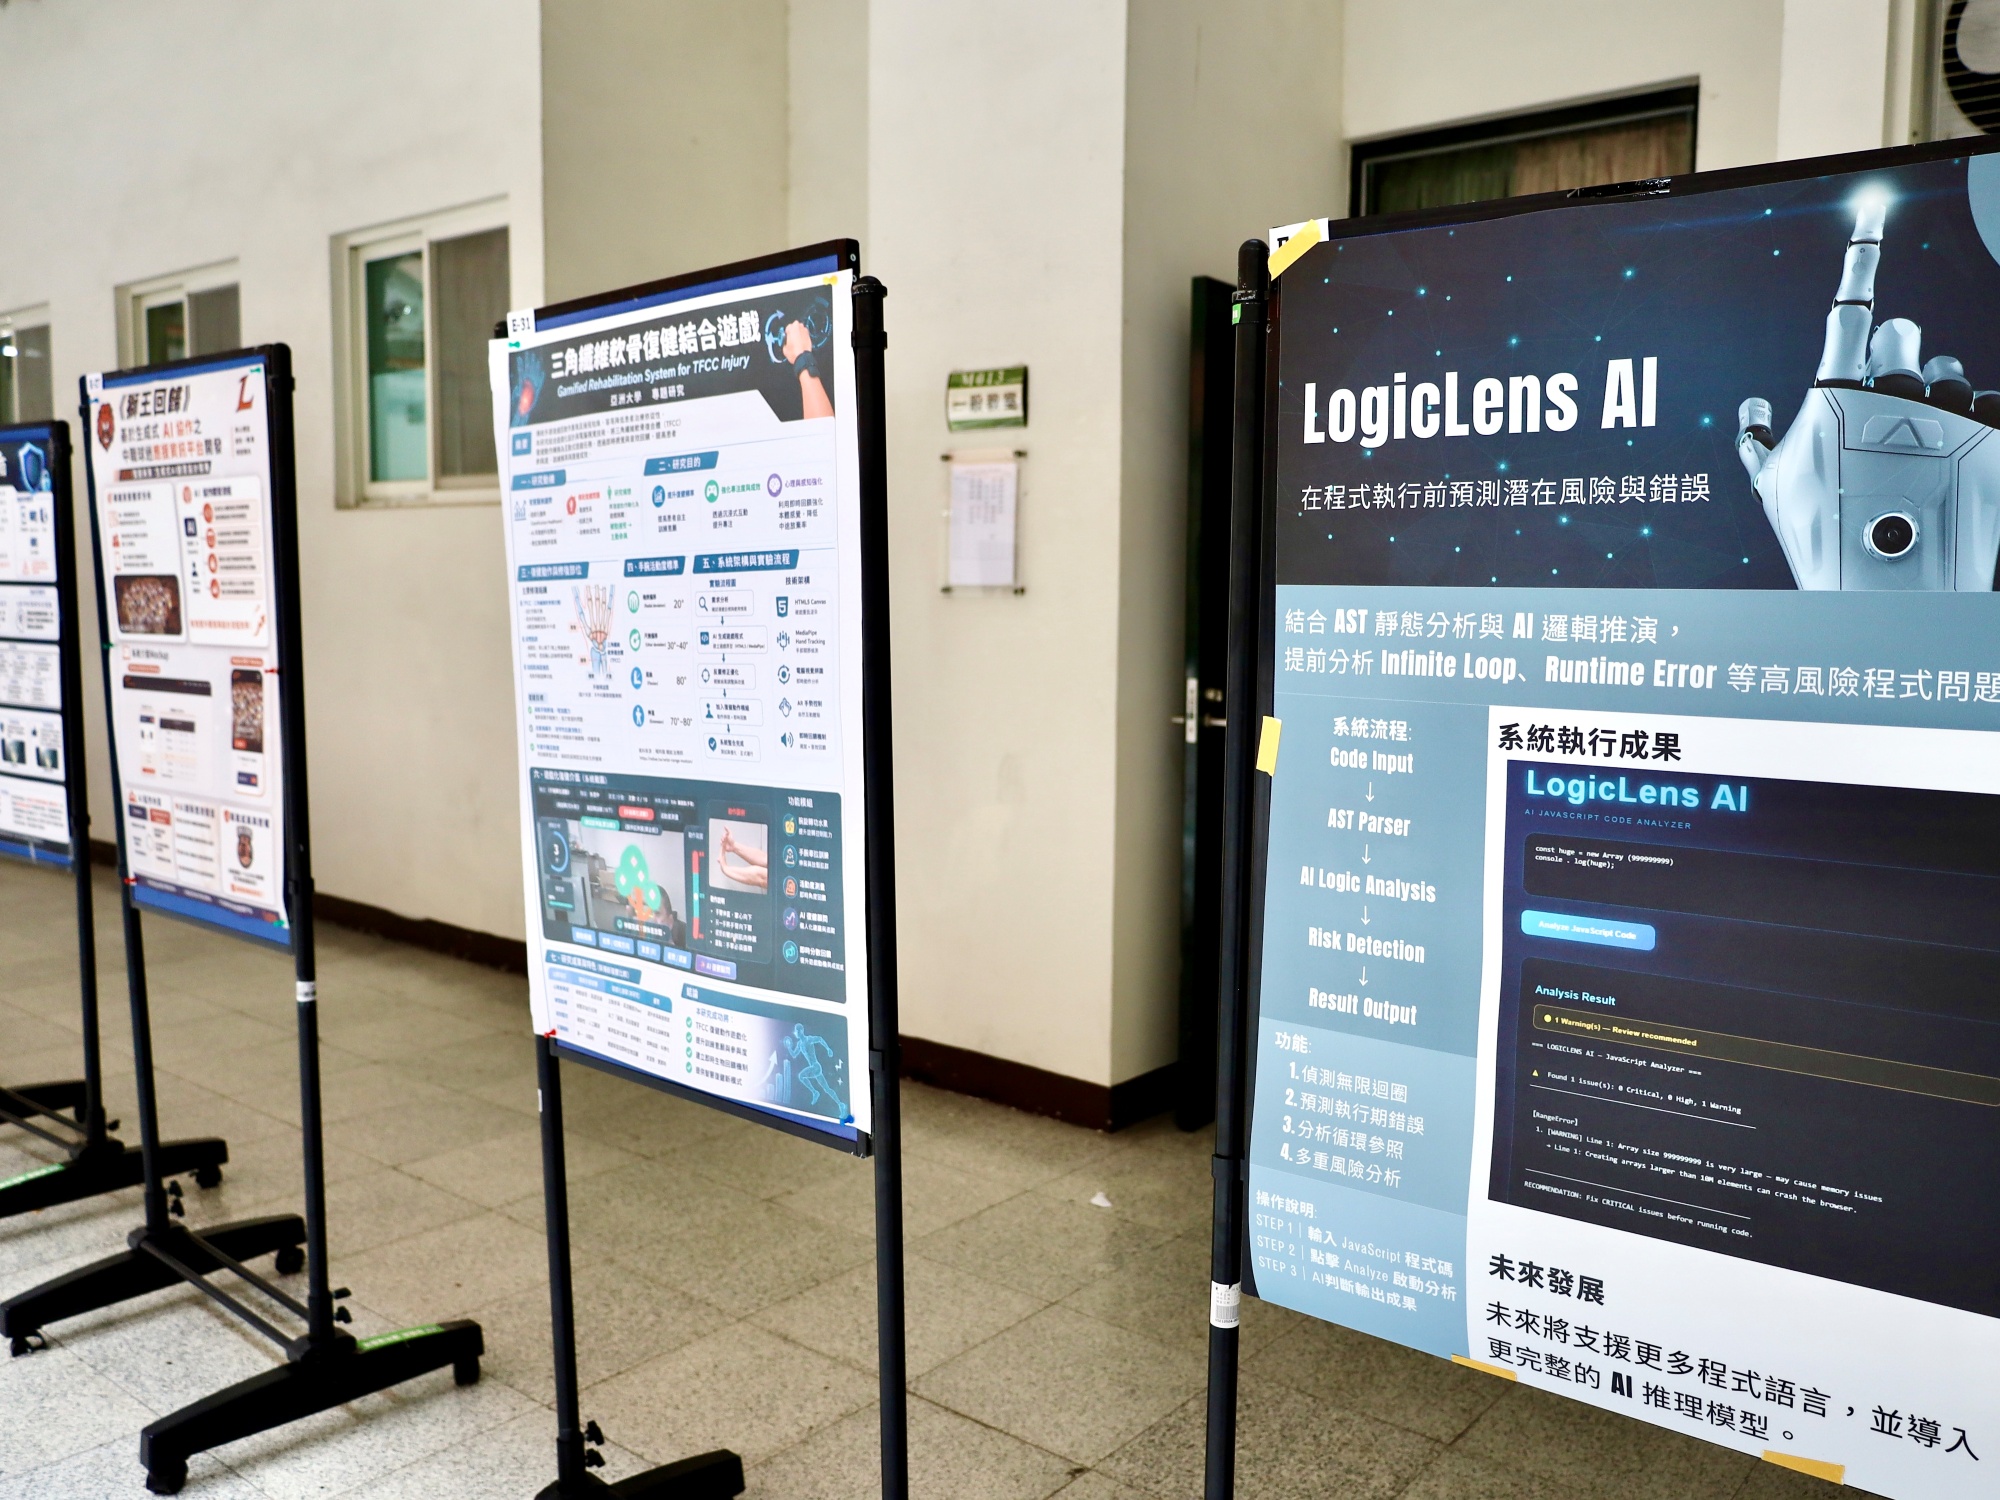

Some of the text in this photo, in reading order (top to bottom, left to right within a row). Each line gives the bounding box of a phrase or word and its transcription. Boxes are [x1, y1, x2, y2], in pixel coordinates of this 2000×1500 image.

[511, 317, 531, 333] E-31
[557, 353, 750, 398] Gamified Rehabilitation System for TFCC Injury
[610, 390, 642, 407] 亞洲大學
[1303, 356, 1658, 449] LogicLens AI
[659, 456, 701, 472] 二、研究目的
[1301, 473, 1711, 512] 在程式執行前預測潛在風險與錯誤
[1284, 608, 1328, 635] 結合
[1333, 608, 1369, 635] AST
[1374, 609, 1504, 640] 靜態分析與
[1512, 612, 1534, 640] AI
[1284, 646, 1374, 676] 提前分析
[1381, 649, 1457, 679] Infinite
[1545, 655, 1645, 687] Runtime
[1653, 659, 1718, 690] Error
[1726, 662, 2000, 703] 等高風險程式問題
[1332, 716, 1413, 743] 系統流程:
[1498, 722, 1682, 762] 系統執行成果
[1330, 746, 1414, 775] Code Input
[1526, 769, 1748, 812] LogicLens AI
[1327, 807, 1411, 837] AST Parser
[1524, 808, 1692, 830] AI JAVASCRIPT CODE ANALYZER
[1535, 845, 1555, 853] const
[1558, 846, 1575, 856] huge
[1602, 851, 1624, 861] Array
[1535, 854, 1563, 863] console
[1300, 865, 1437, 903] AI Logic Analysis
[1308, 926, 1426, 964] Risk Detection
[1538, 920, 1637, 940] Analyze JavaScript Code
[1308, 987, 1417, 1027] Result Output
[1535, 984, 1616, 1006] Analysis Result
[696, 1021, 709, 1032] TFCC
[1274, 1030, 1312, 1054] 功能:
[1560, 1017, 1697, 1046] Warning(s) Review recommended
[1547, 1043, 1685, 1073] LOGICLENS AI JavaScript Analyzer
[1547, 1071, 1742, 1115] Found issue(s): Critical, High, Warning
[1532, 1109, 1578, 1126] [RangeError]
[1547, 1128, 1583, 1142] [WARNING]
[1586, 1136, 1603, 1146] Line
[1617, 1142, 1640, 1154] Array
[1642, 1148, 1660, 1157] size
[1718, 1164, 1736, 1174] very
[1740, 1167, 1763, 1179] large
[1793, 1179, 1817, 1189] cause
[1820, 1184, 1850, 1197] memory
[1854, 1190, 1883, 1203] issues
[1554, 1143, 1570, 1153] Line
[1585, 1150, 1618, 1165] Creating
[1621, 1158, 1646, 1169] arrays
[1650, 1163, 1676, 1176] larger
[1679, 1170, 1697, 1180] than
[1717, 1177, 1753, 1191] elements
[1774, 1190, 1798, 1201] crash
[1820, 1199, 1857, 1213] browser.
[1524, 1180, 1753, 1238] RECOMMENDATION: Fix CRITICAL issues before running code.
[1256, 1213, 1284, 1231] STEP
[1307, 1225, 1338, 1248] 輸入
[1341, 1235, 1401, 1264] JavaScript
[1404, 1250, 1454, 1279] 程式碼
[1257, 1234, 1457, 1302] STEP 2 點擊 Analyze 啟動分析
[1258, 1255, 1287, 1275] STEP
[1290, 1264, 1297, 1277] 3
[1488, 1253, 1606, 1307] 未來發展
[1486, 1301, 1980, 1462] 未來將支援更多程式語言，並導入
[1487, 1336, 1795, 1442] 更完整的 AI 推理模型。
